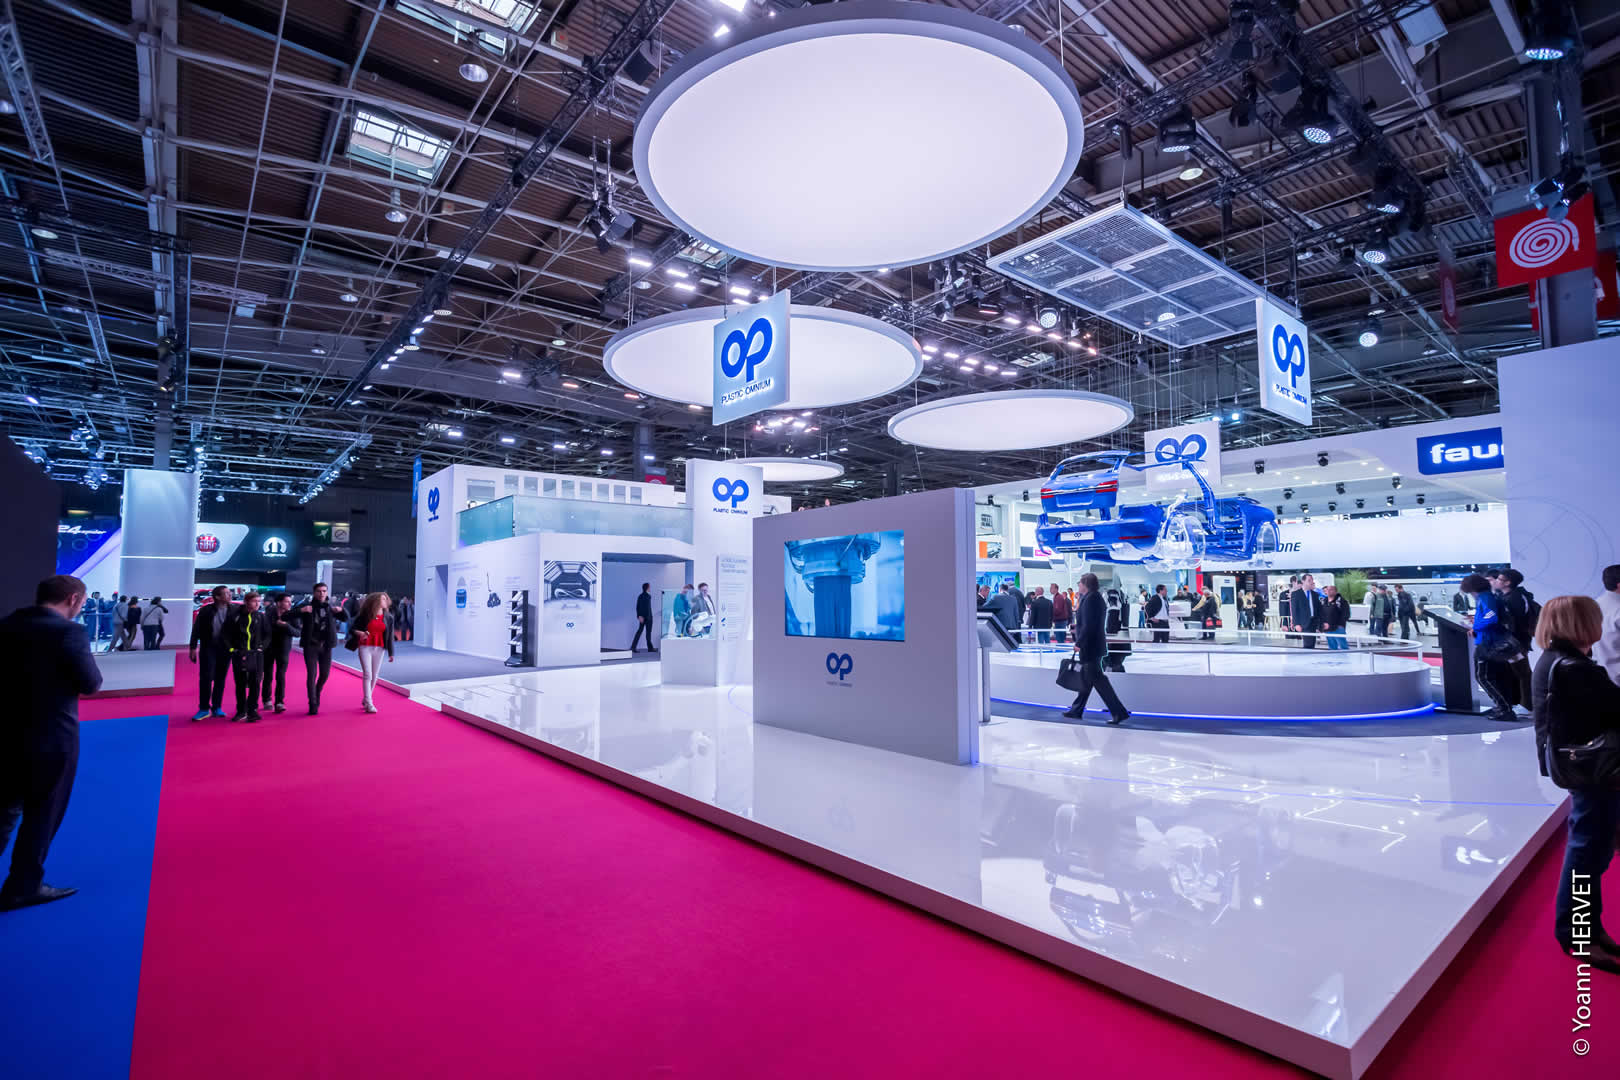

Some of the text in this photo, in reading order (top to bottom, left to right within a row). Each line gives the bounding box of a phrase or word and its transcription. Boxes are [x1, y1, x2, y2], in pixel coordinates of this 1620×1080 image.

[721, 378, 771, 404] PLASTIC OMNIUM
[1430, 443, 1504, 464] fau
